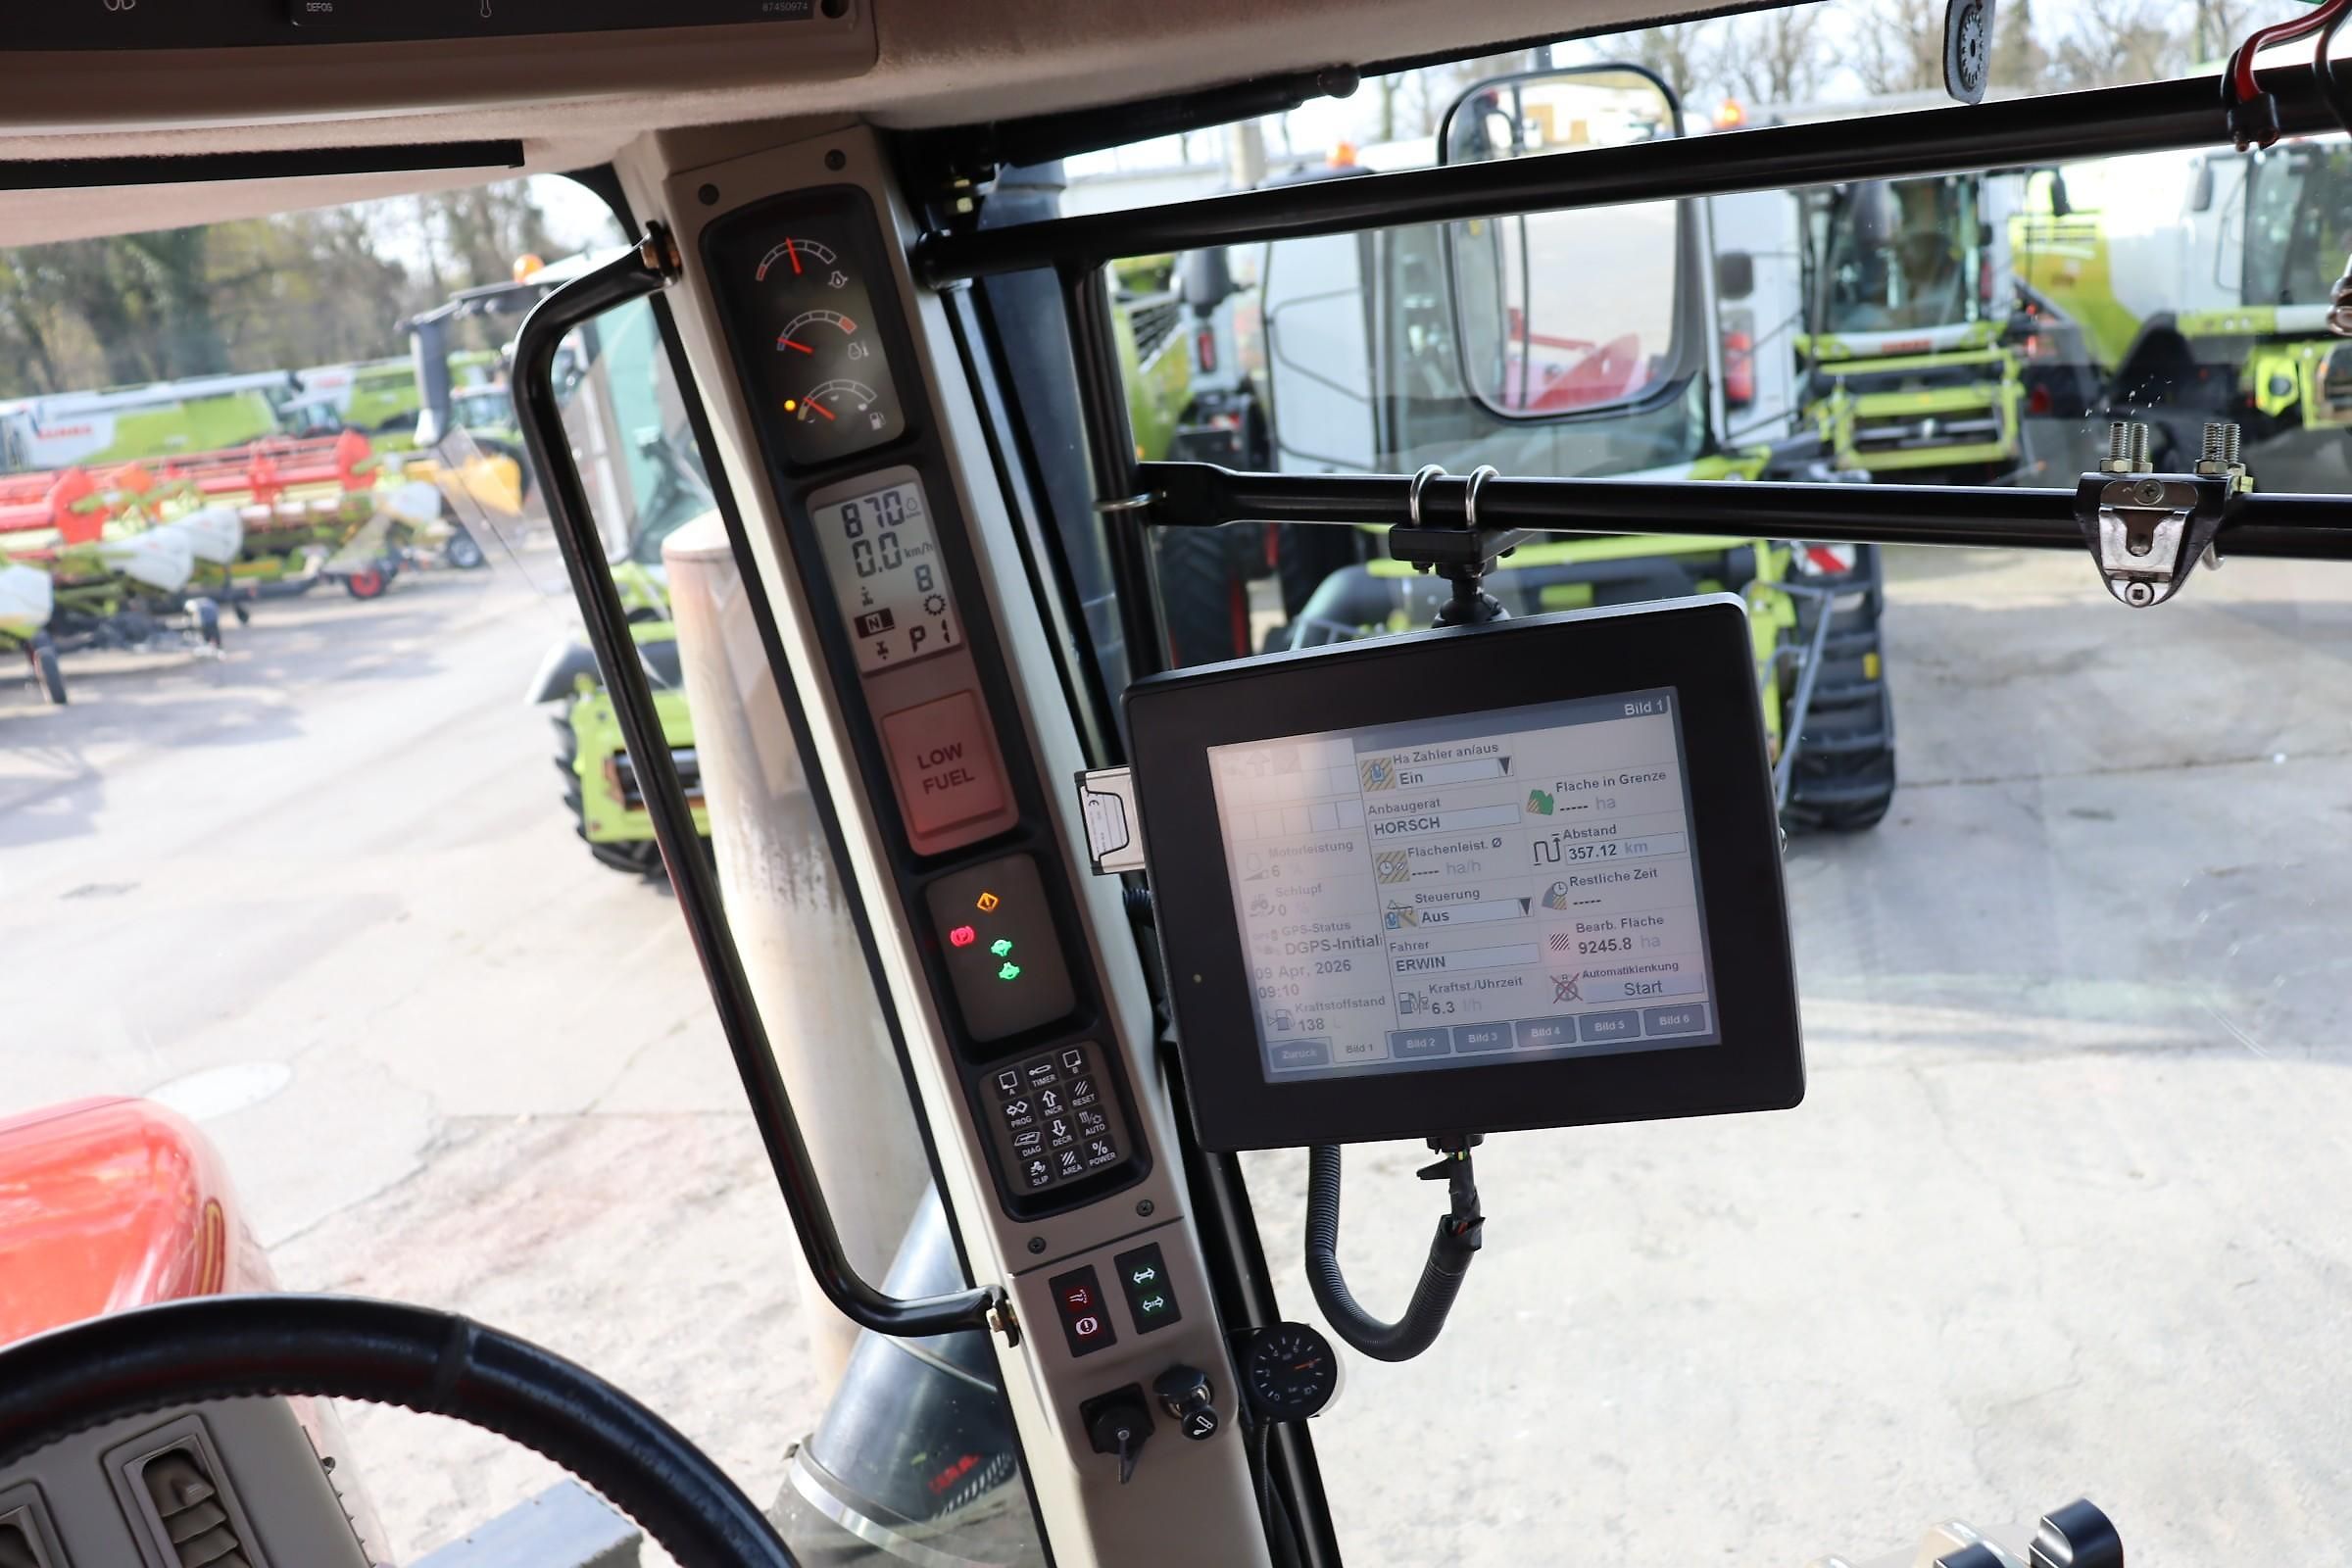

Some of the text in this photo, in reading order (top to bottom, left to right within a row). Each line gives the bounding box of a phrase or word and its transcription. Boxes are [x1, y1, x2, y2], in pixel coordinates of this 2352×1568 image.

[840, 491, 906, 539] 870
[852, 531, 903, 578] 0.0
[867, 614, 881, 631] N
[1624, 699, 1663, 715] Bild 1
[917, 743, 963, 770] LOW
[922, 767, 976, 796] FUEL
[1398, 771, 1424, 785] Ein
[1603, 775, 1616, 787] in
[1619, 770, 1667, 785] Grenze
[1595, 797, 1616, 810] ha
[1373, 816, 1441, 835] HORSCH
[1563, 824, 1617, 841] Abstand
[1268, 840, 1354, 859] Motorleistung
[1568, 841, 1648, 860] 357.12 km
[1569, 867, 1658, 887] Restliche Zeit
[1276, 883, 1323, 900] Schlupf
[1415, 889, 1481, 904] Steuerung
[1421, 910, 1450, 923] Aus
[1282, 921, 1351, 936] GPS-Status
[1390, 941, 1430, 953] Fahrer
[1578, 935, 1661, 955] 9245.8 ha
[1255, 966, 1273, 980] 09
[1315, 958, 1352, 975] 2026
[1396, 956, 1446, 972] ERWIN
[1581, 961, 1680, 980] Automatiklenkung
[1258, 983, 1300, 999] 09:10
[1624, 980, 1663, 996] Start
[1295, 995, 1386, 1013] Kraftstoffstand
[1431, 1001, 1456, 1015] 6.3
[1298, 1017, 1325, 1032] 138
[1594, 1021, 1616, 1032] Bild
[1659, 1015, 1681, 1026] Bild
[1468, 1033, 1489, 1044] Bild
[1531, 1027, 1553, 1038] Bild
[1346, 1043, 1366, 1054] Bild
[1406, 1039, 1427, 1050] Bild
[1032, 1073, 1056, 1088] TIMER
[1072, 1094, 1096, 1107] RESET
[1044, 1104, 1063, 1117] INCR
[1010, 1115, 1033, 1128] PROG
[1085, 1123, 1105, 1137] AUTO
[1052, 1135, 1073, 1147] DECR
[1022, 1145, 1042, 1157] DIAG
[1089, 1152, 1117, 1167] POWER
[1062, 1164, 1083, 1176] AREA
[1033, 1175, 1049, 1187] SLIP
